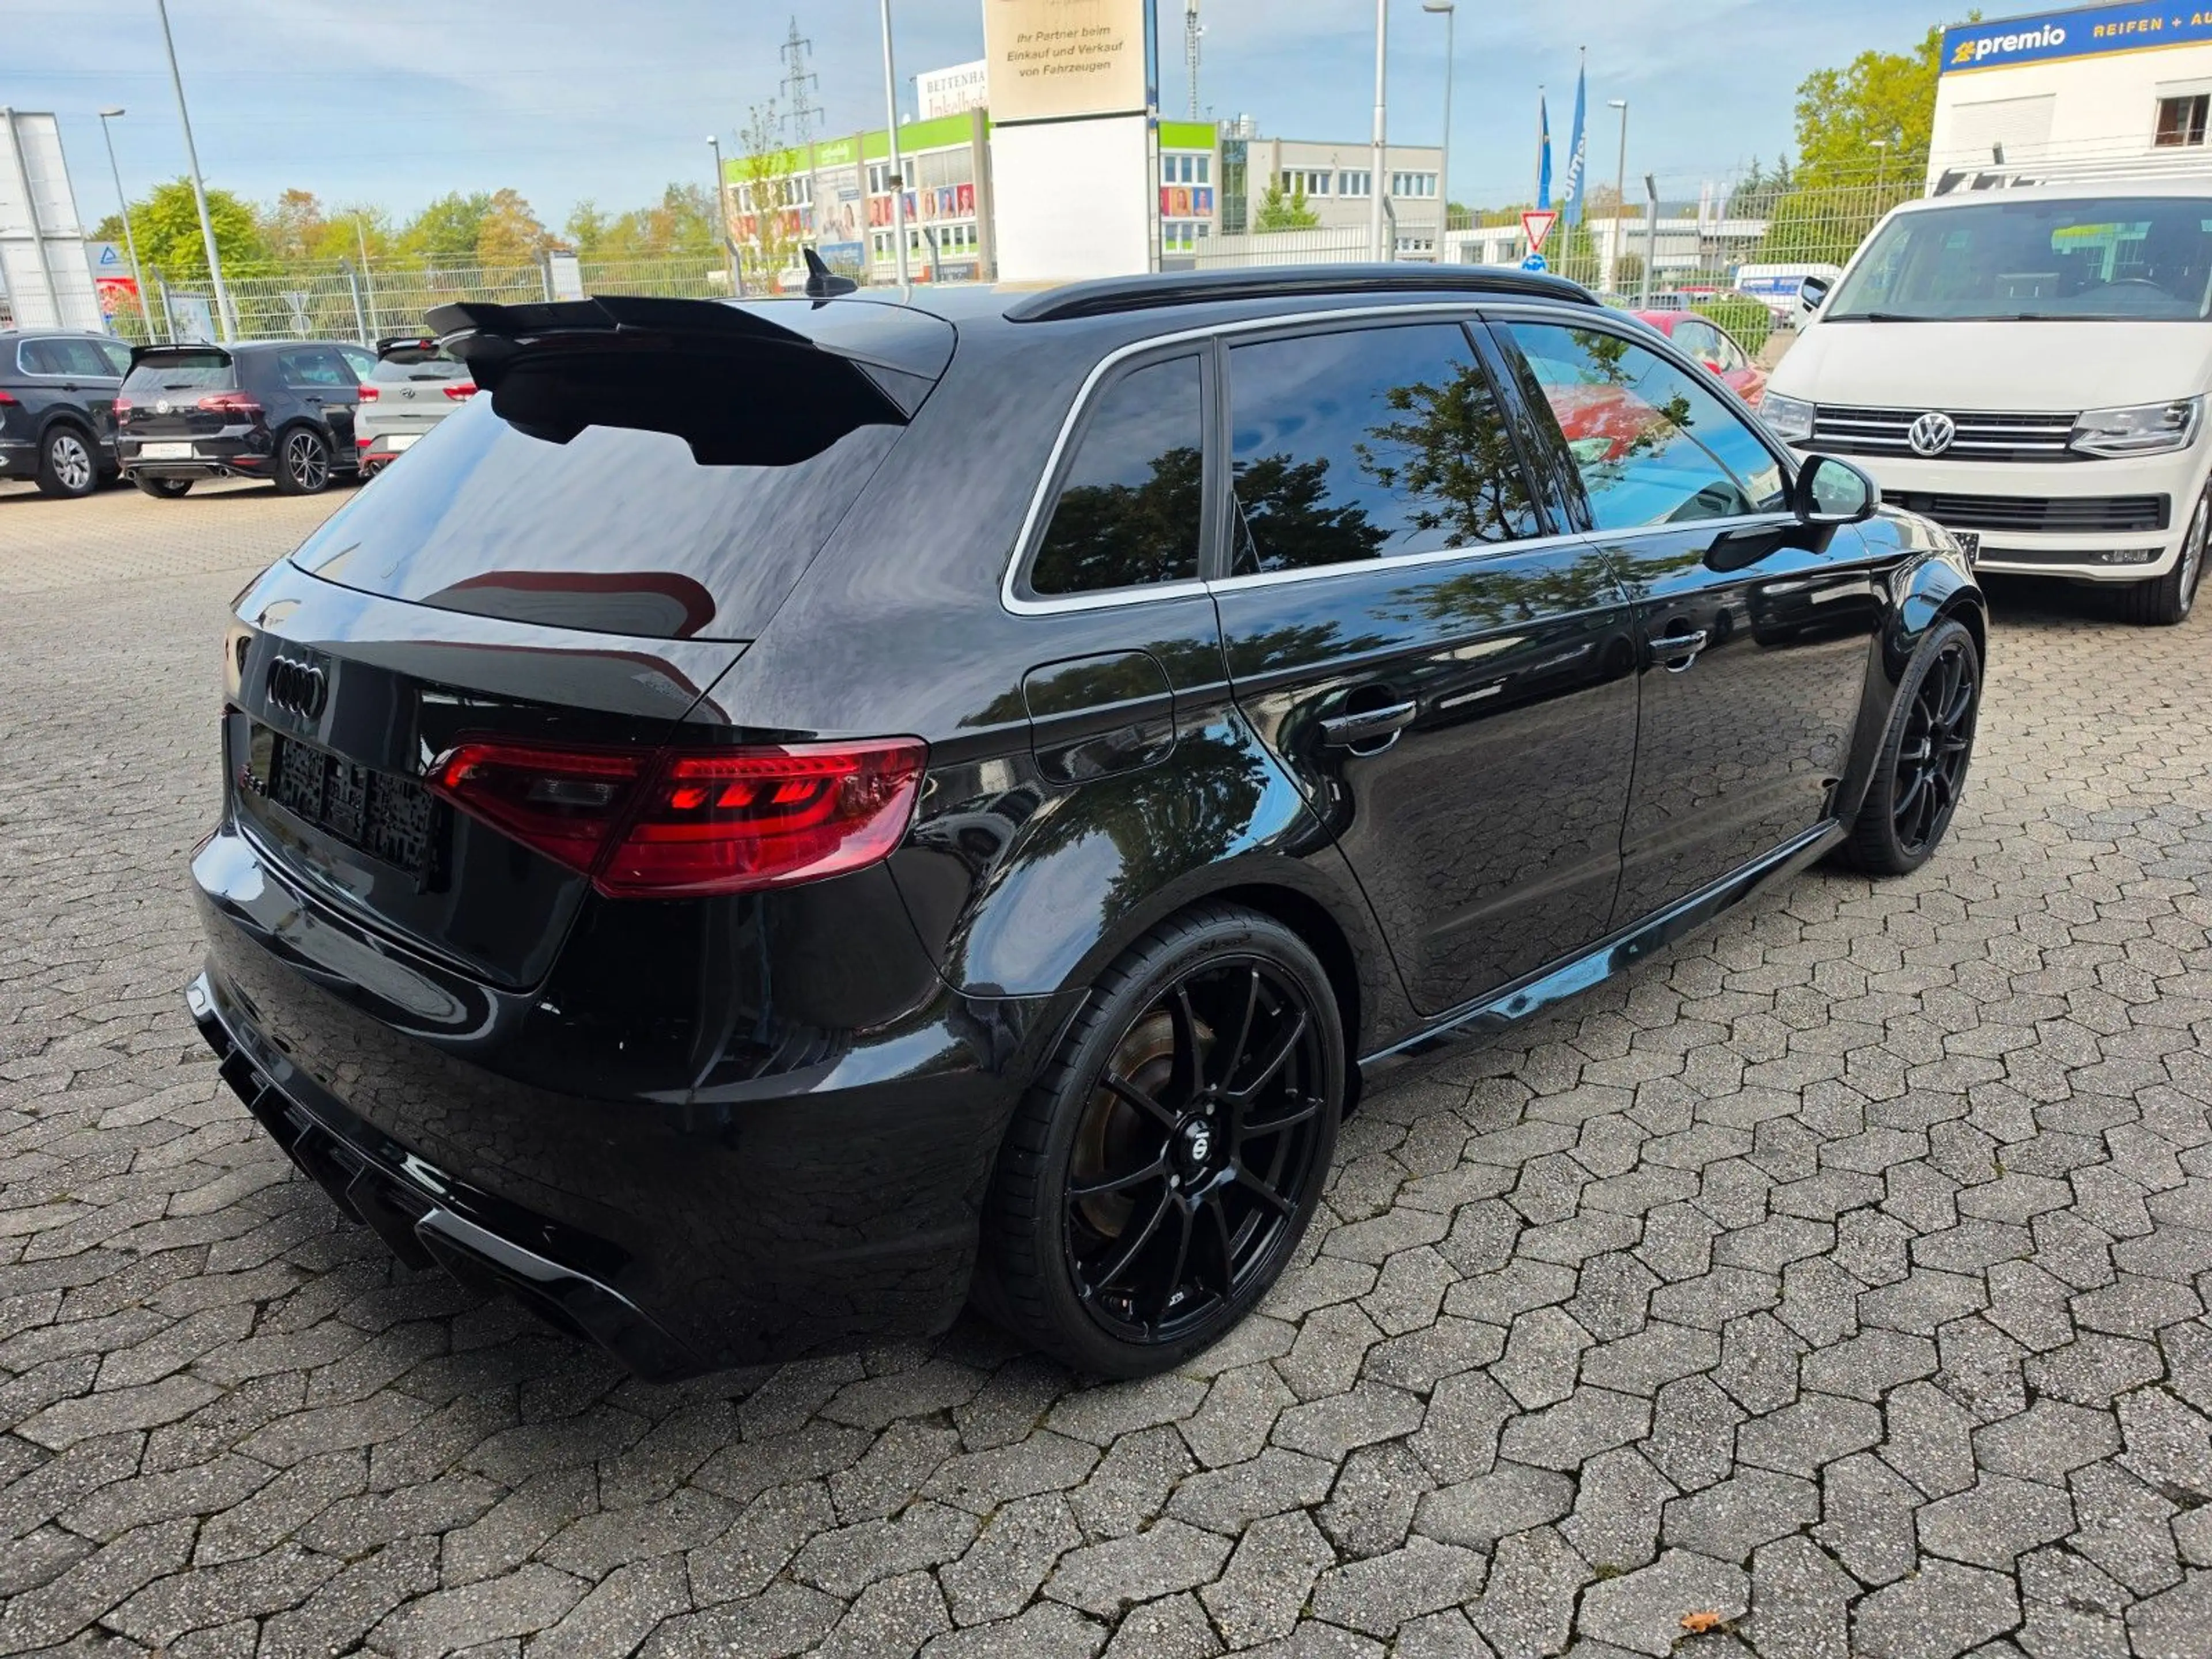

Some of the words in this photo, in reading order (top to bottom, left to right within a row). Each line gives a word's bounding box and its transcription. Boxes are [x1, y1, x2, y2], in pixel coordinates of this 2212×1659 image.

[1017, 33, 1032, 43] Ihr
[1035, 29, 1079, 42] Partner
[1081, 25, 1111, 37] beim
[2093, 18, 2162, 38] REIFEN
[1007, 48, 1049, 62] Einkauf
[1052, 46, 1075, 56] und
[1078, 40, 1124, 55] Verkauf
[1975, 25, 2066, 60] premio
[1019, 68, 1040, 77] von
[1043, 61, 1112, 75] Fahrzeugen
